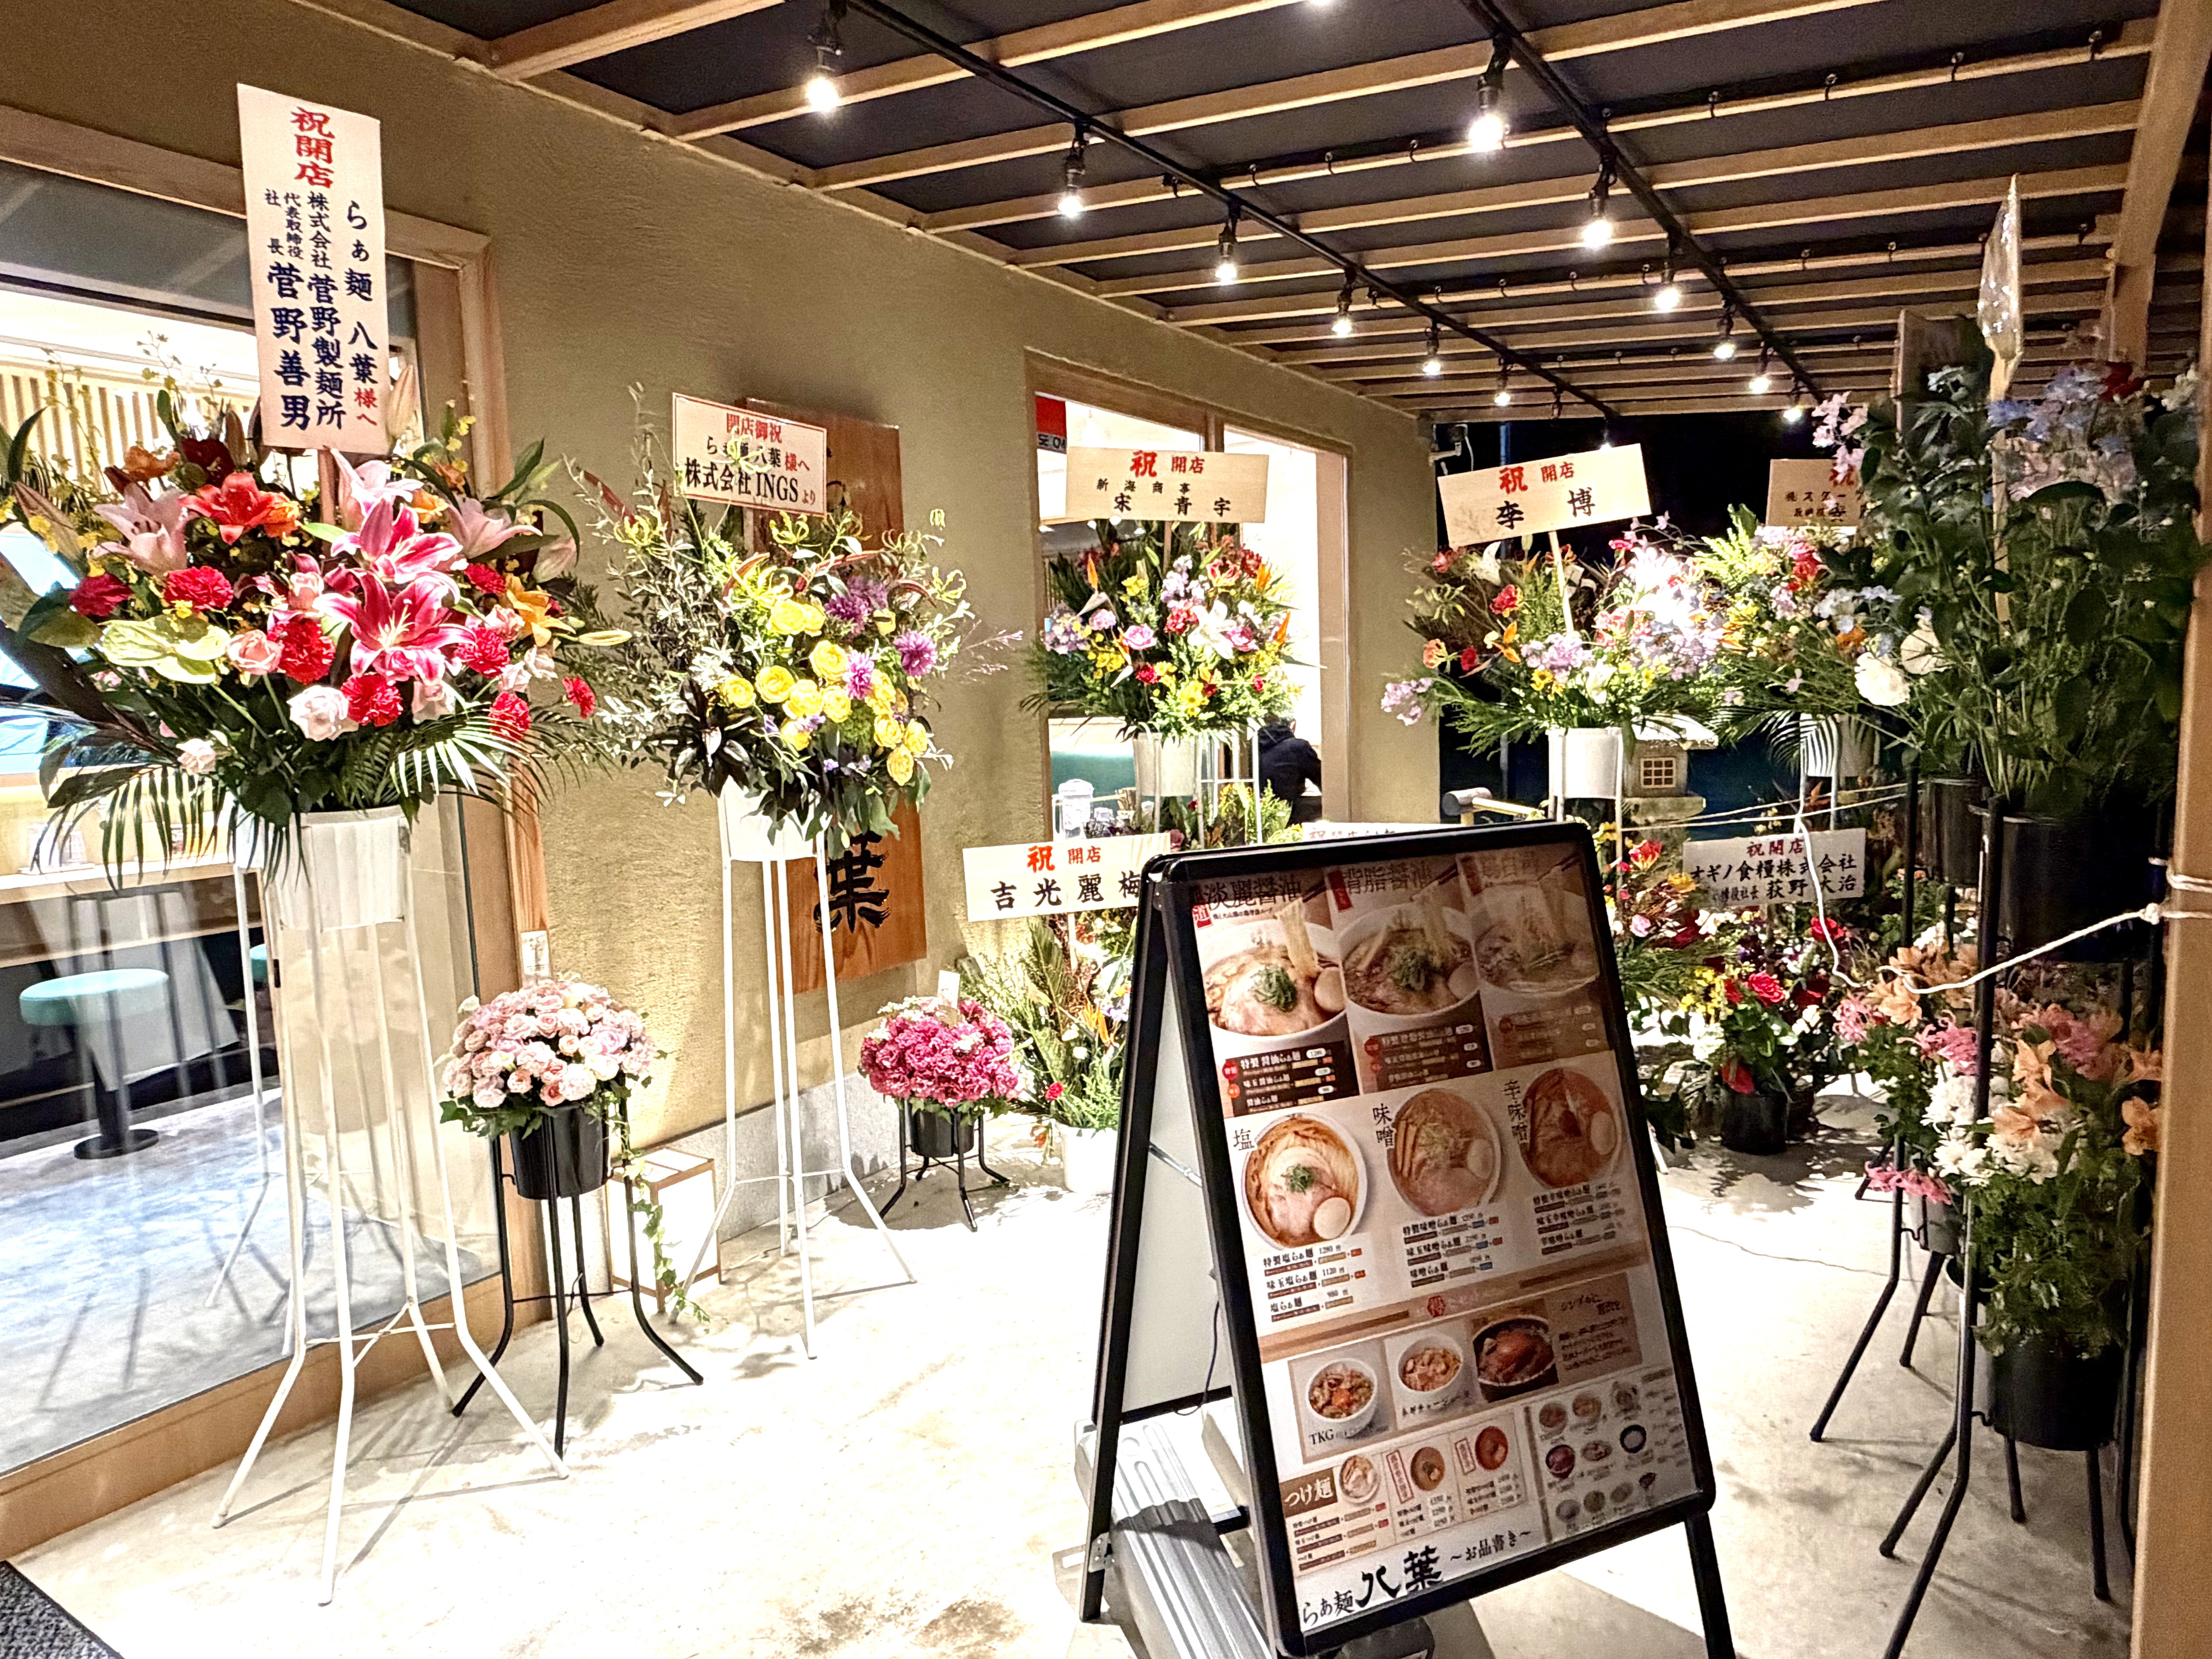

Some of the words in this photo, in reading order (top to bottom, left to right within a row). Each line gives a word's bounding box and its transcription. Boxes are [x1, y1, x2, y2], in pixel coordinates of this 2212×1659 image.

[291, 106, 335, 189] 祝開店
[267, 262, 311, 431] 菅野善男
[1130, 450, 1158, 478] 祝
[1171, 456, 1205, 474] 開店
[1499, 465, 1528, 495] 祝
[1540, 461, 1575, 483] 開店
[1027, 845, 1055, 873] 祝
[1067, 845, 1101, 865] 開店
[1746, 839, 1805, 857] 祝開店
[1233, 1128, 1255, 1151] 塩
[1309, 1429, 1334, 1445] TKG
[1284, 1477, 1334, 1507] つけ麺
[1303, 1590, 1355, 1625] らぁ麺
[1355, 1545, 1442, 1607] 八葉
